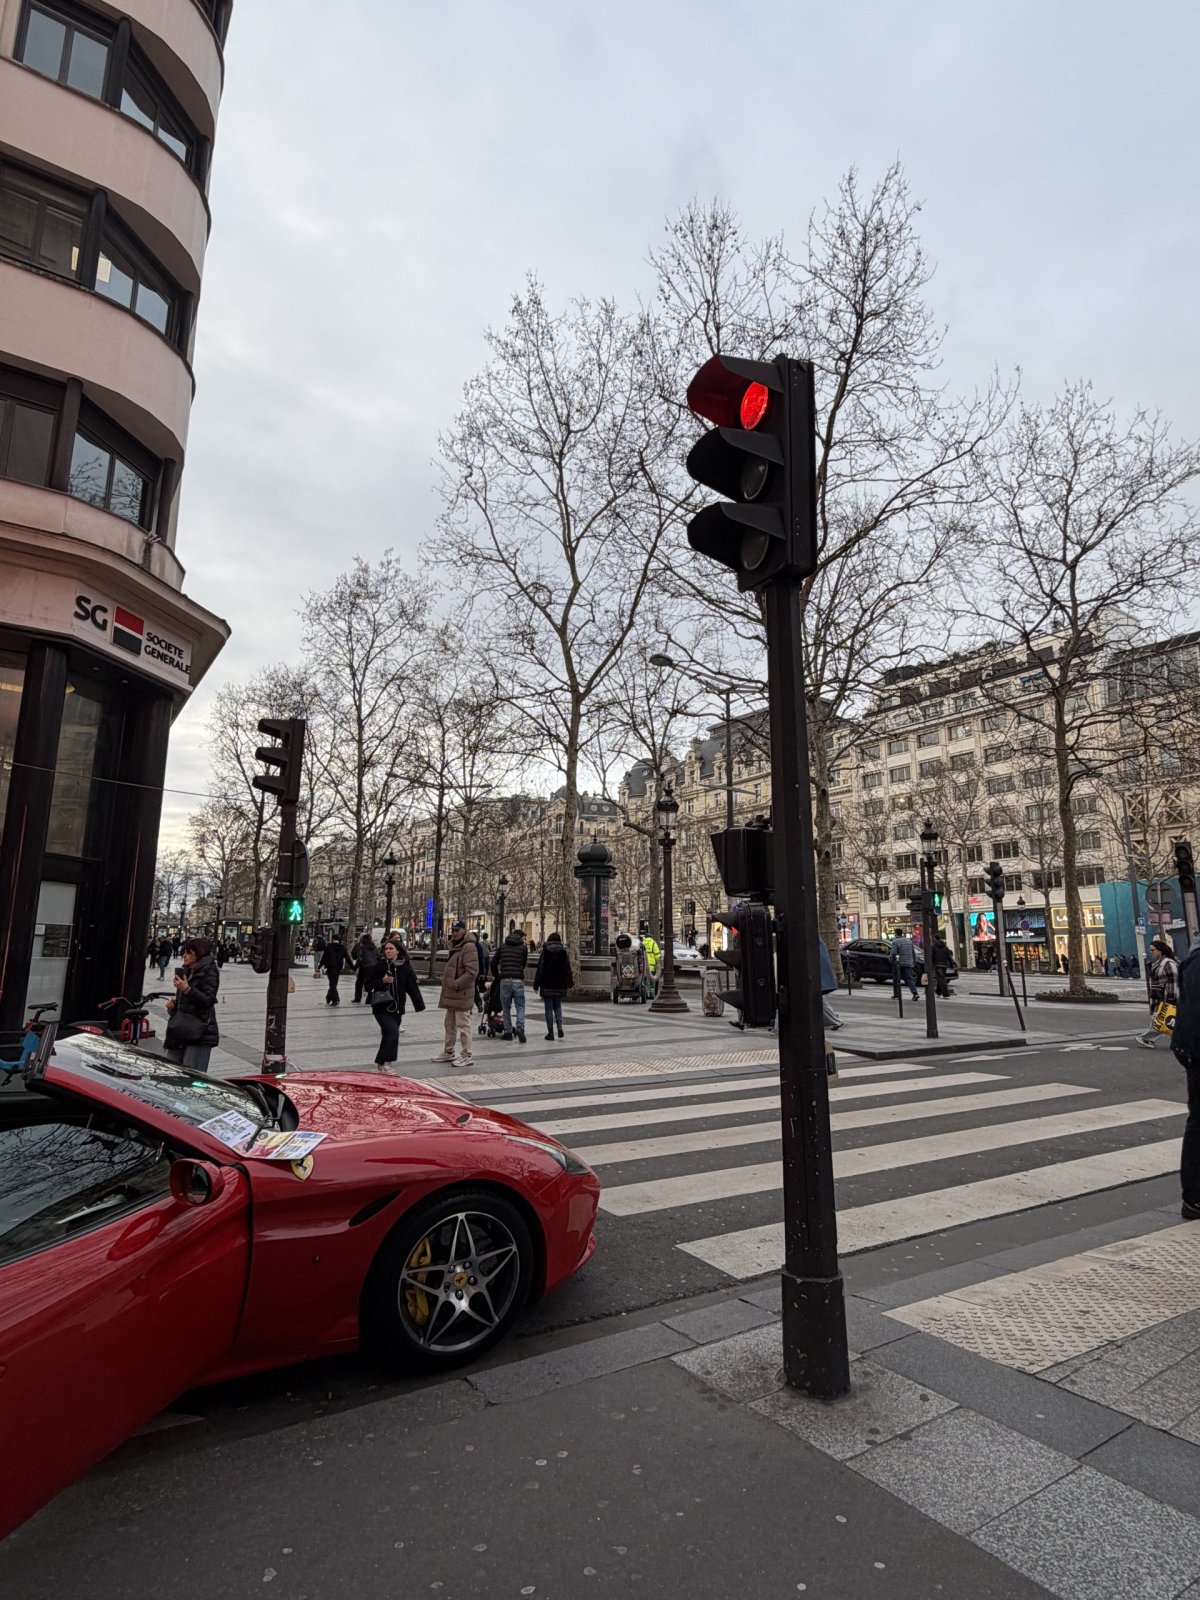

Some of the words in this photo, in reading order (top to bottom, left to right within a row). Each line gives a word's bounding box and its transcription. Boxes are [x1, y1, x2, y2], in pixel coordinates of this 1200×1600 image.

[74, 595, 108, 631] SG
[144, 645, 191, 675] GENERALE
[146, 632, 184, 659] SOCIETE
